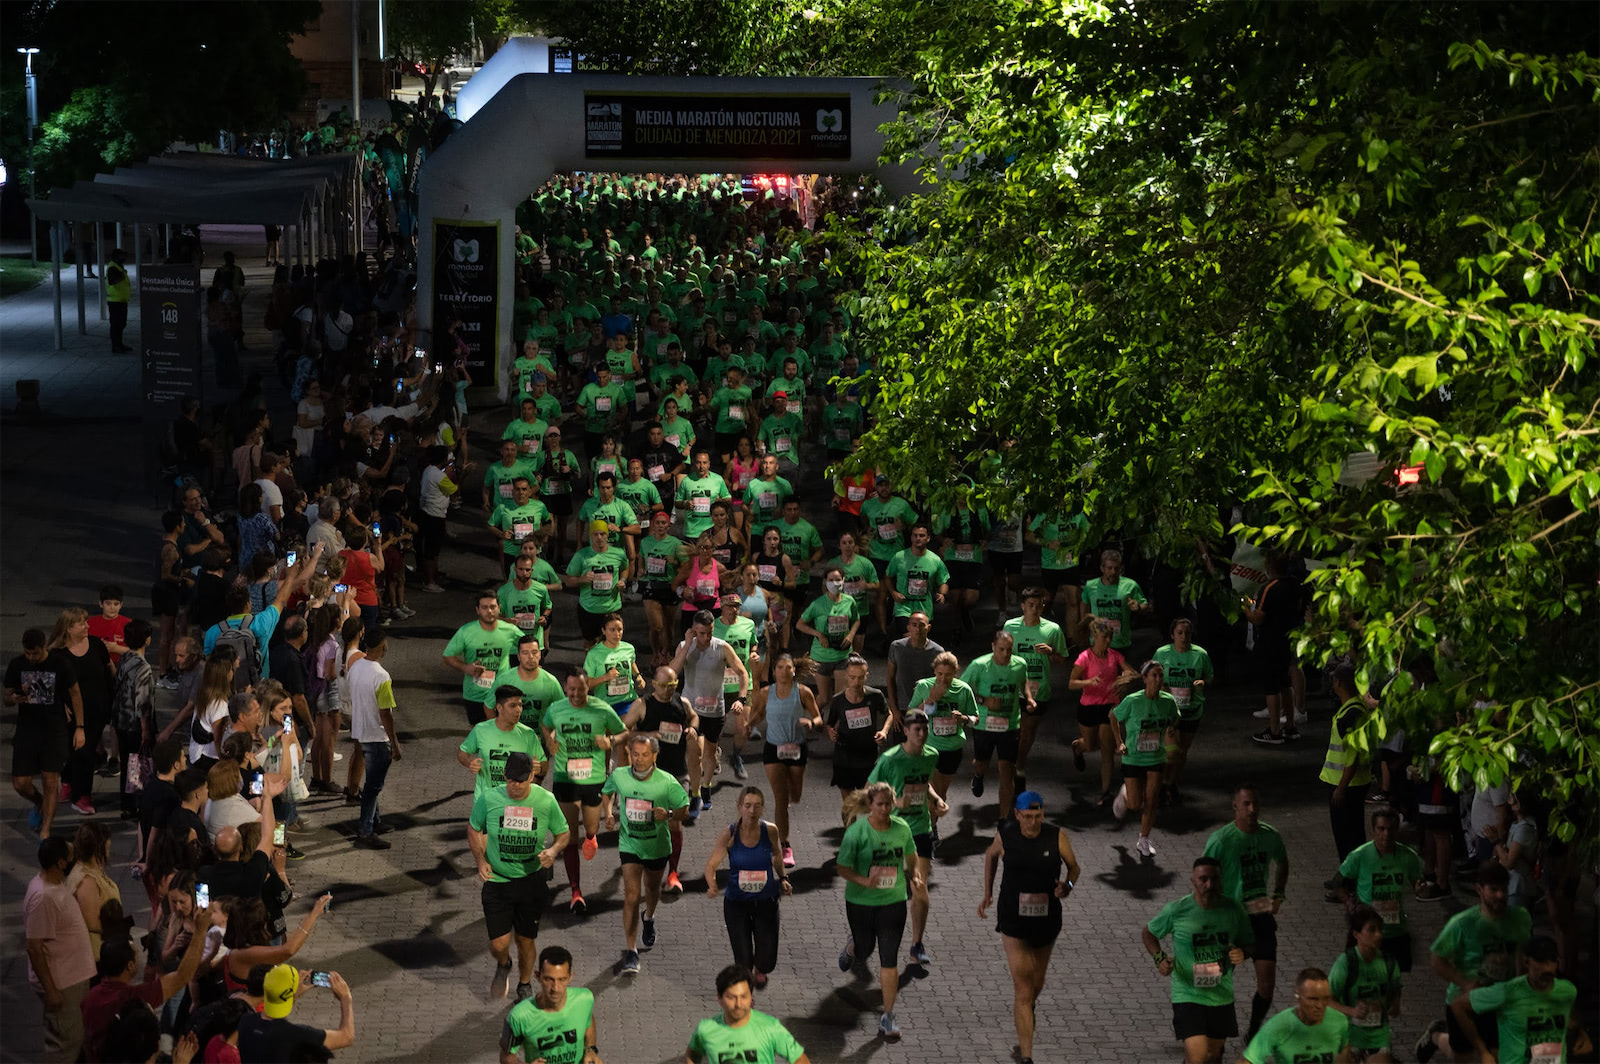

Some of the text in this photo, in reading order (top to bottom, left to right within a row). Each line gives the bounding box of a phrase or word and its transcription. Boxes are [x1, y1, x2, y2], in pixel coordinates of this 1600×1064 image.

[635, 107, 801, 127] MEDIA MARATÓN NOCTURNA
[587, 121, 623, 131] MARATON
[635, 127, 801, 145] CIUDAD DE MENDOZA 2021
[810, 133, 848, 141] mendoza
[141, 276, 194, 286] Ventanilla Única
[161, 309, 179, 323] 148
[506, 818, 529, 828] 2298
[498, 835, 538, 845] MARATON
[742, 882, 765, 891] 2318
